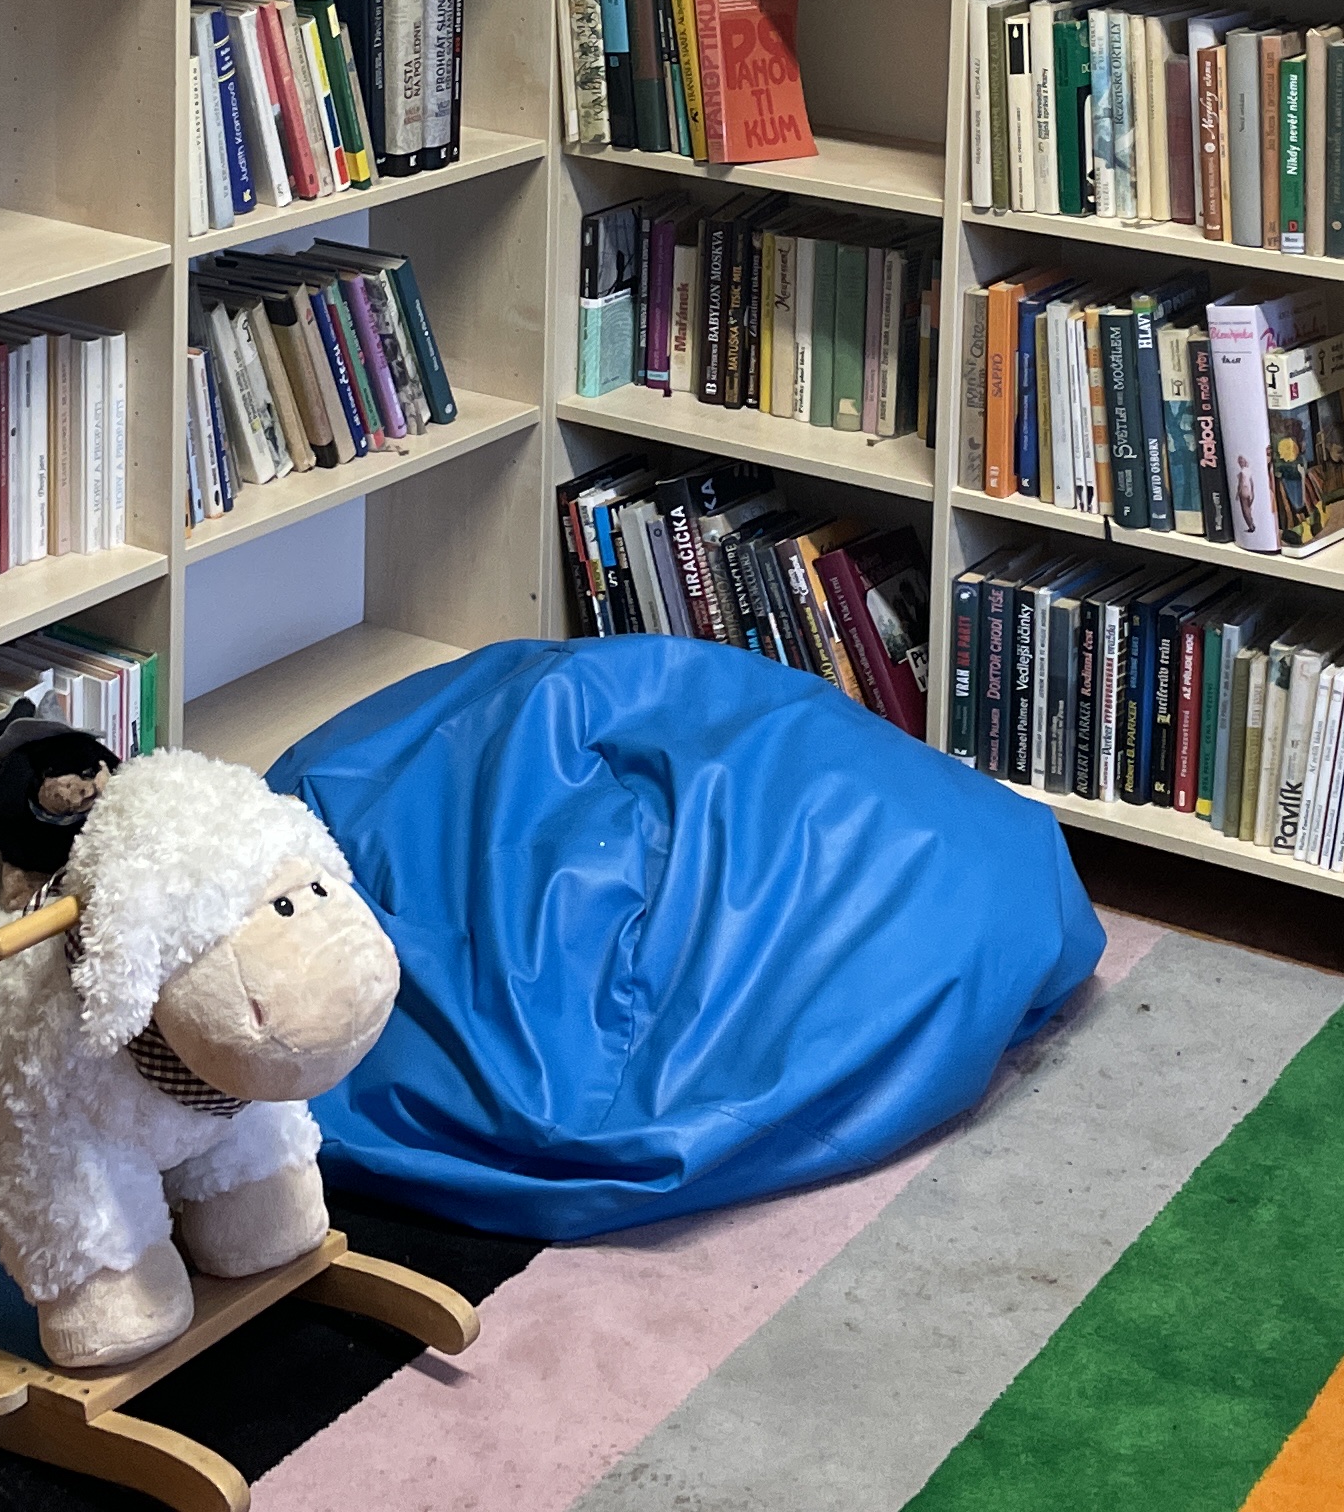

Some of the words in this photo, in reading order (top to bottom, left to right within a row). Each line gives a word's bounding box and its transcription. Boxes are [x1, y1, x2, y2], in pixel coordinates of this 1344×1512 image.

[711, 230, 723, 279] MOSKVA
[708, 281, 720, 342] BABYLON
[670, 505, 703, 597] HRAČIČKA
[1020, 604, 1033, 642] účinky
[1015, 644, 1032, 691] Vedlejší
[1018, 697, 1028, 732] Palmer
[1017, 733, 1028, 771] Michael
[1274, 780, 1302, 850] Pavlík
